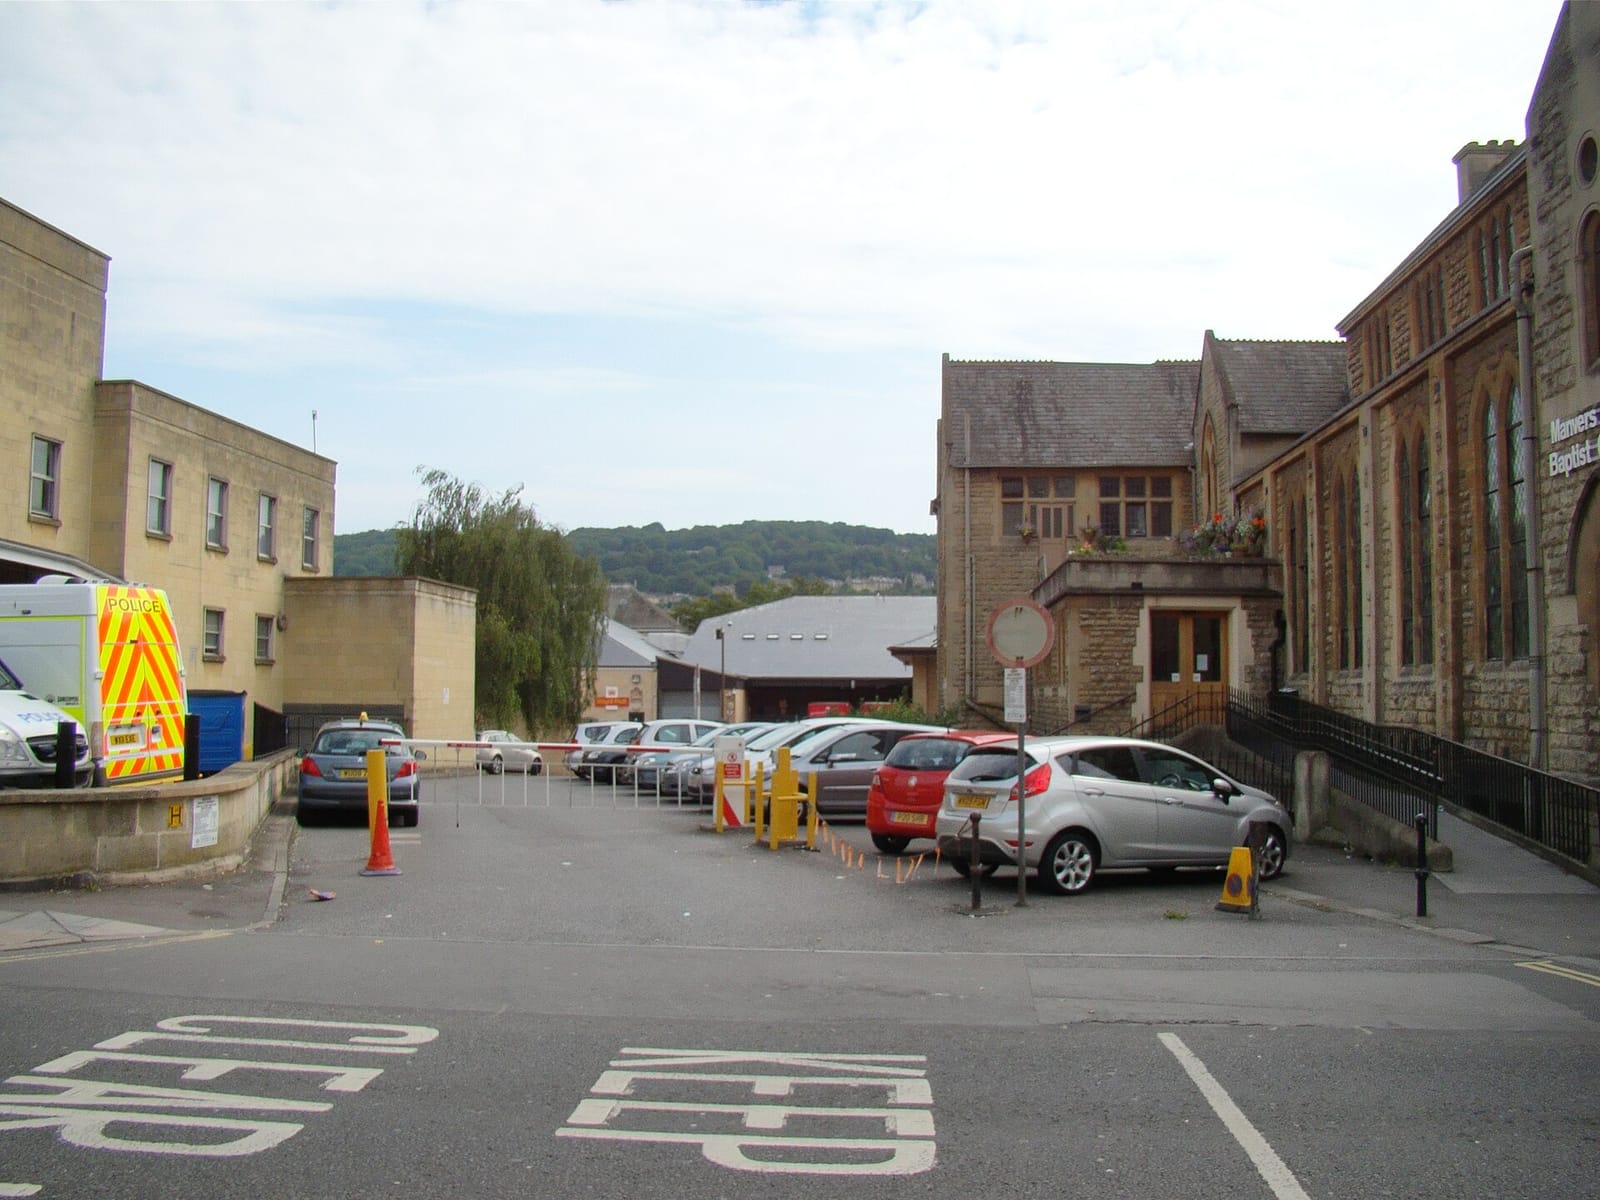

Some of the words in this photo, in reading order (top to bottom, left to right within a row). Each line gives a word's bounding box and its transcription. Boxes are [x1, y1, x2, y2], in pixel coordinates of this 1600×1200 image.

[1551, 408, 1598, 444] Manvers
[1549, 439, 1594, 478] Baptist
[108, 598, 161, 613] POLICE
[0, 1015, 439, 1157] CLEAR
[555, 1047, 936, 1175] KEEP
